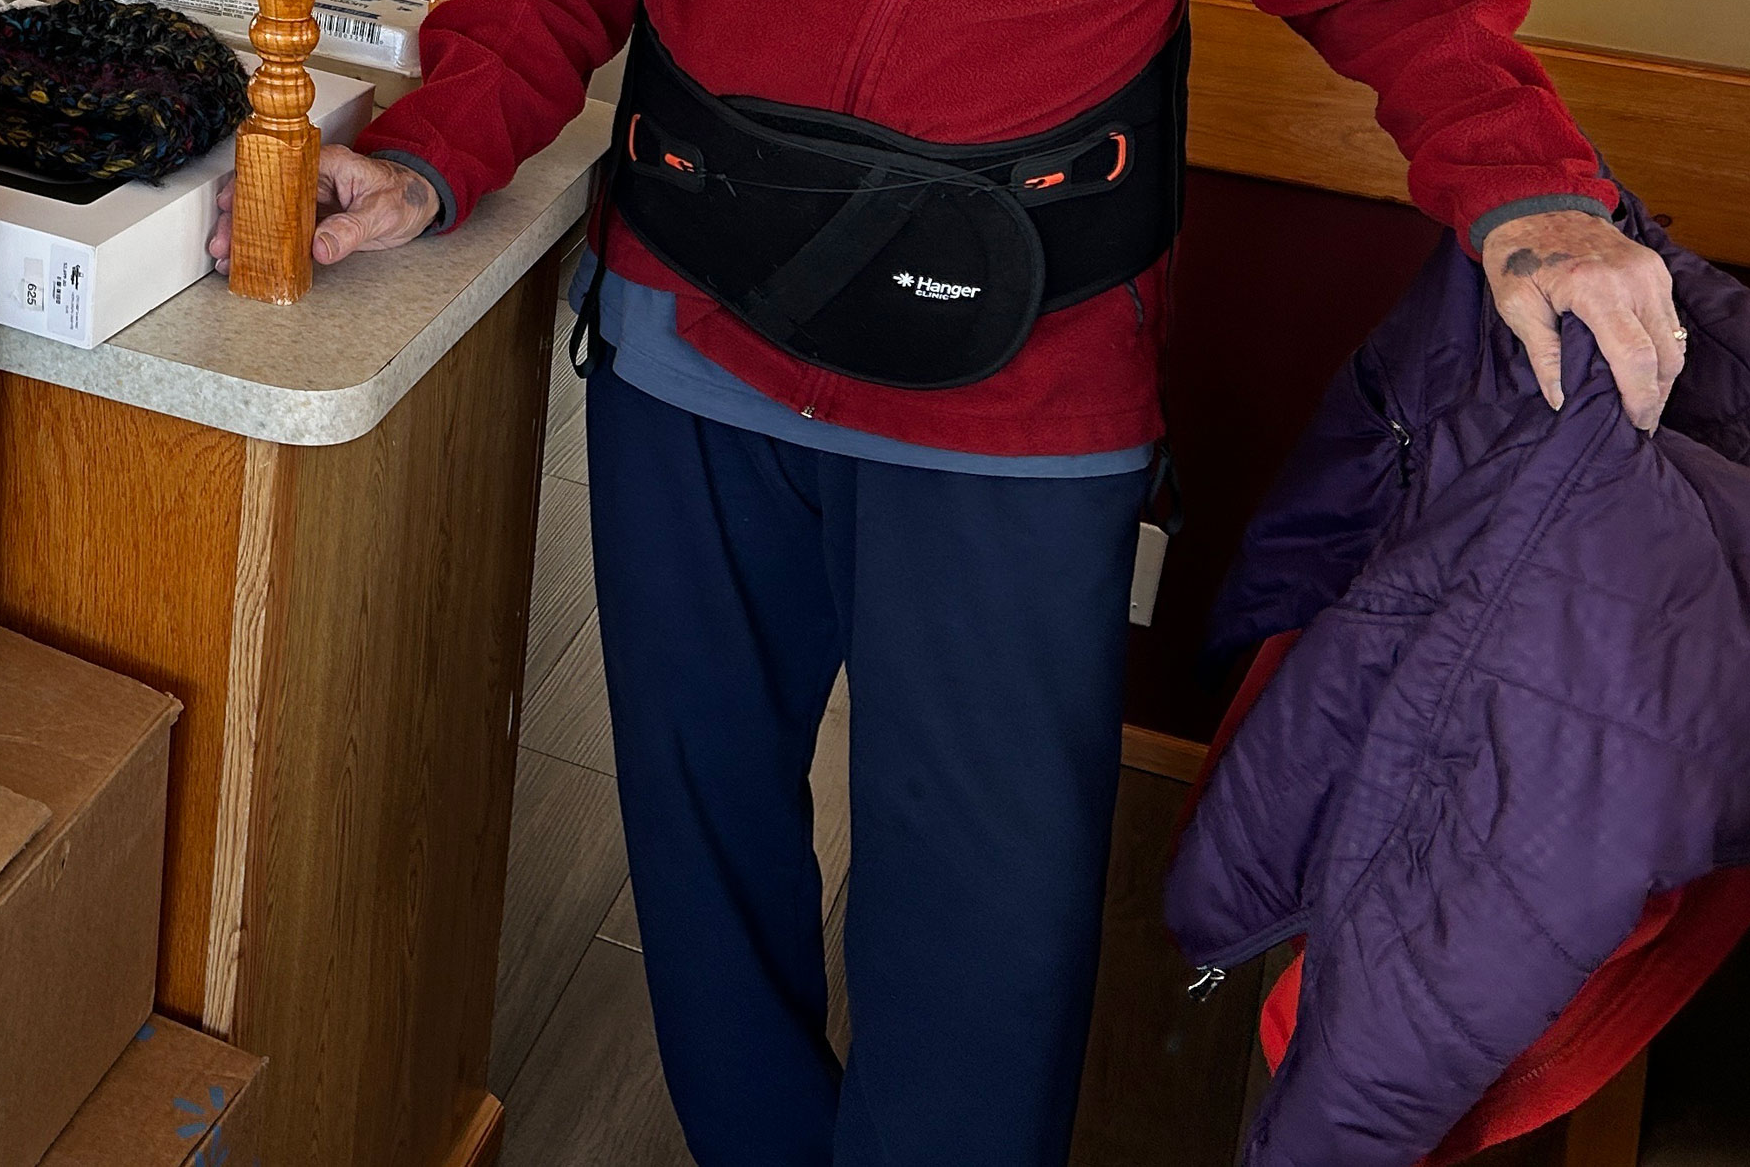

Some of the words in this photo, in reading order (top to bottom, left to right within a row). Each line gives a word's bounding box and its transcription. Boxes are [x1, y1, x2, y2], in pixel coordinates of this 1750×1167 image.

[27, 283, 37, 306] 625
[915, 289, 950, 301] CLINIC
[916, 276, 981, 299] Hanger
